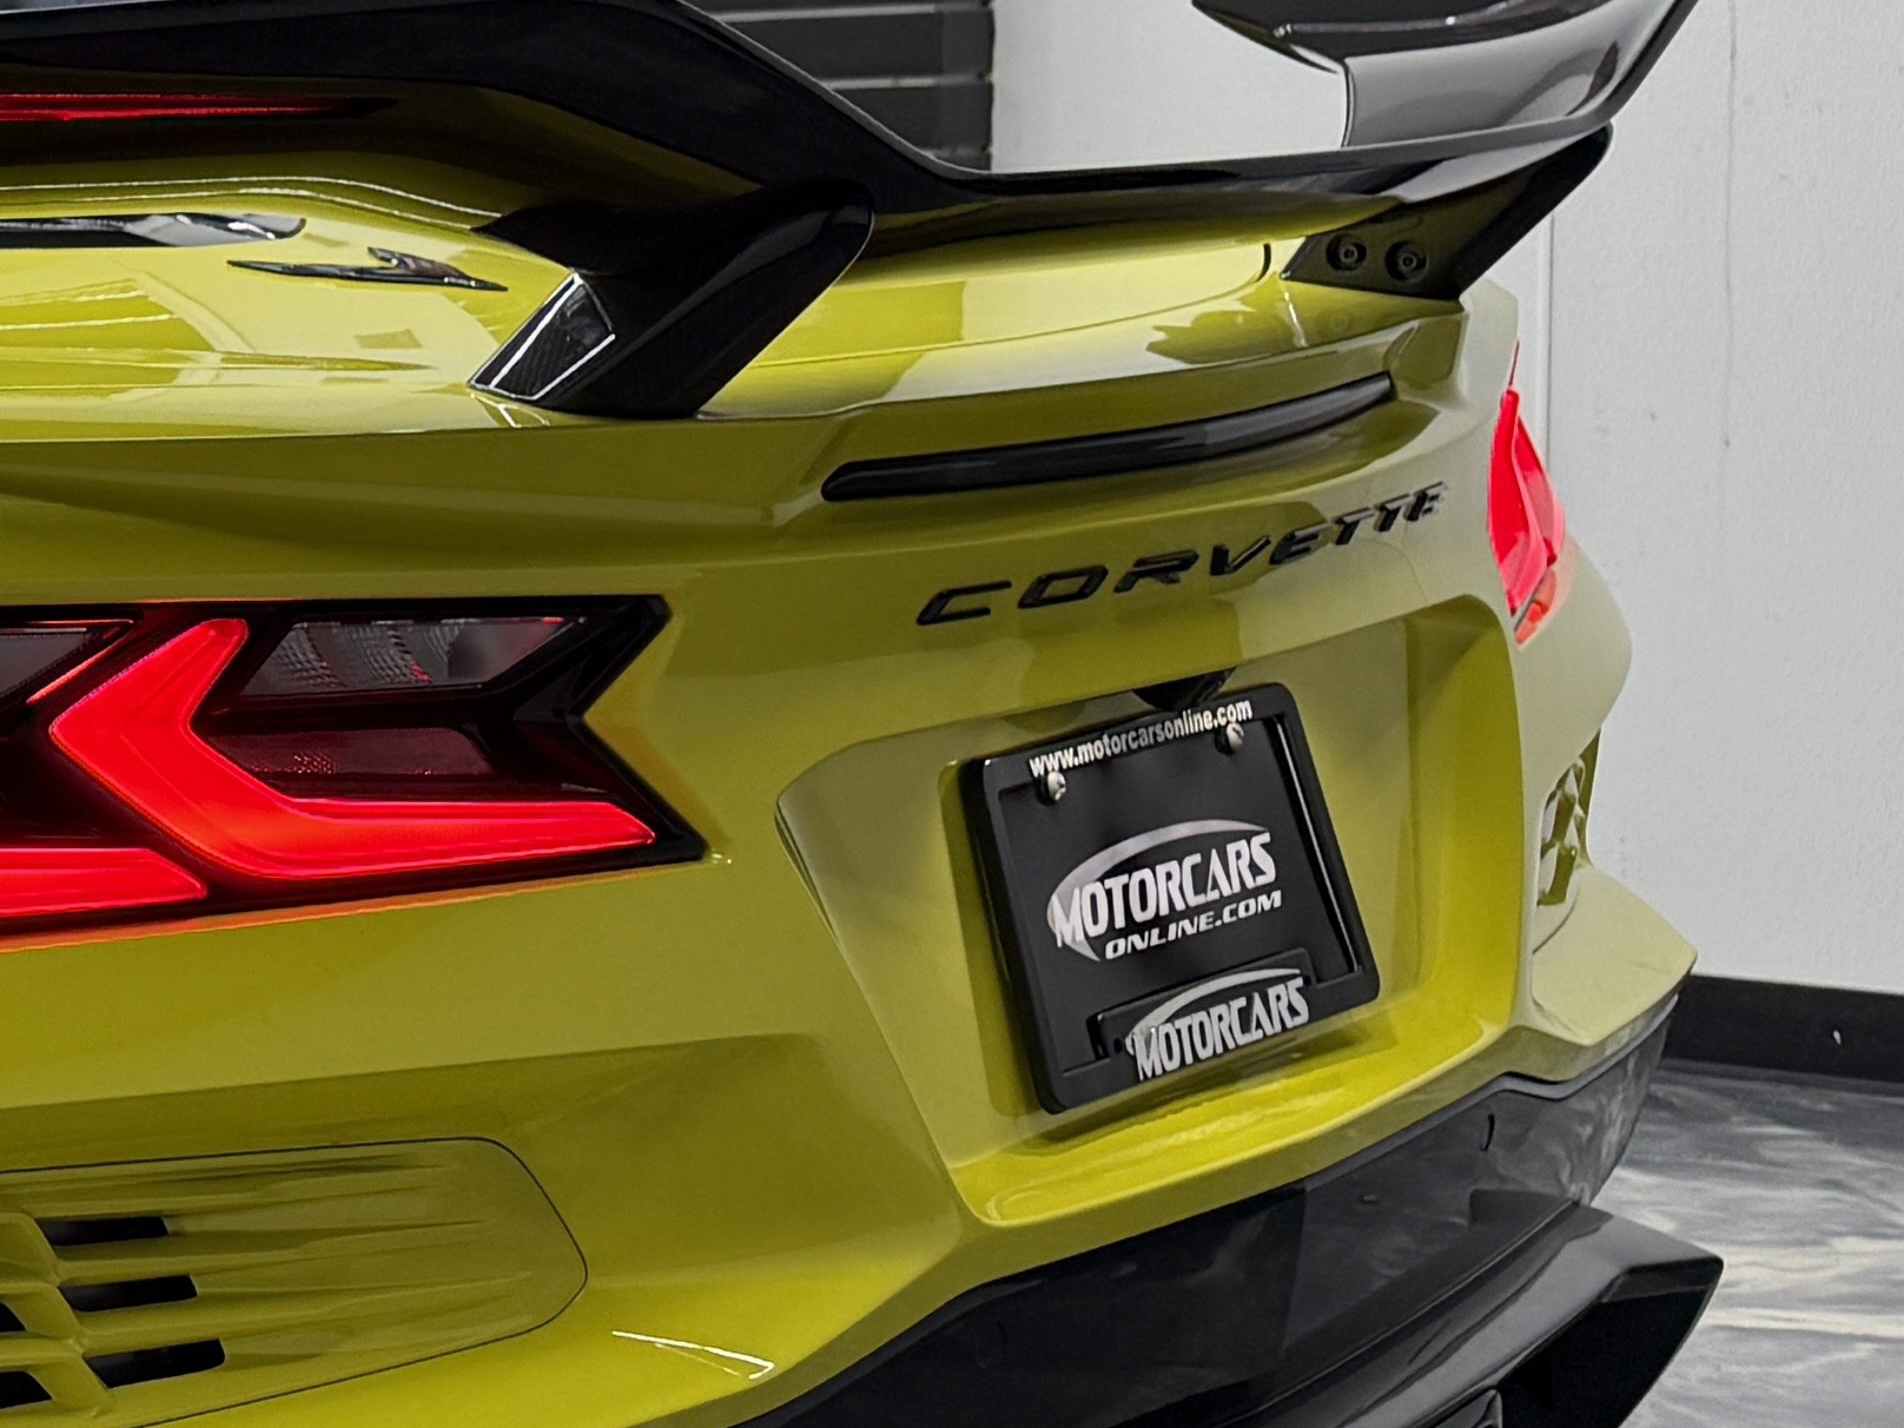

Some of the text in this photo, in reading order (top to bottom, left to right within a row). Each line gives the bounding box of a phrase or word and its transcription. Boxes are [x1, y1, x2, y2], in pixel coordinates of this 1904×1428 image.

[916, 482, 1449, 626] CORVETTE
[1029, 698, 1253, 776] www.motorcarsonline.com
[1050, 832, 1277, 949] MOTORCARS
[1104, 889, 1283, 961] ONLINE.COM
[1131, 977, 1310, 1082] MOTORCARS
